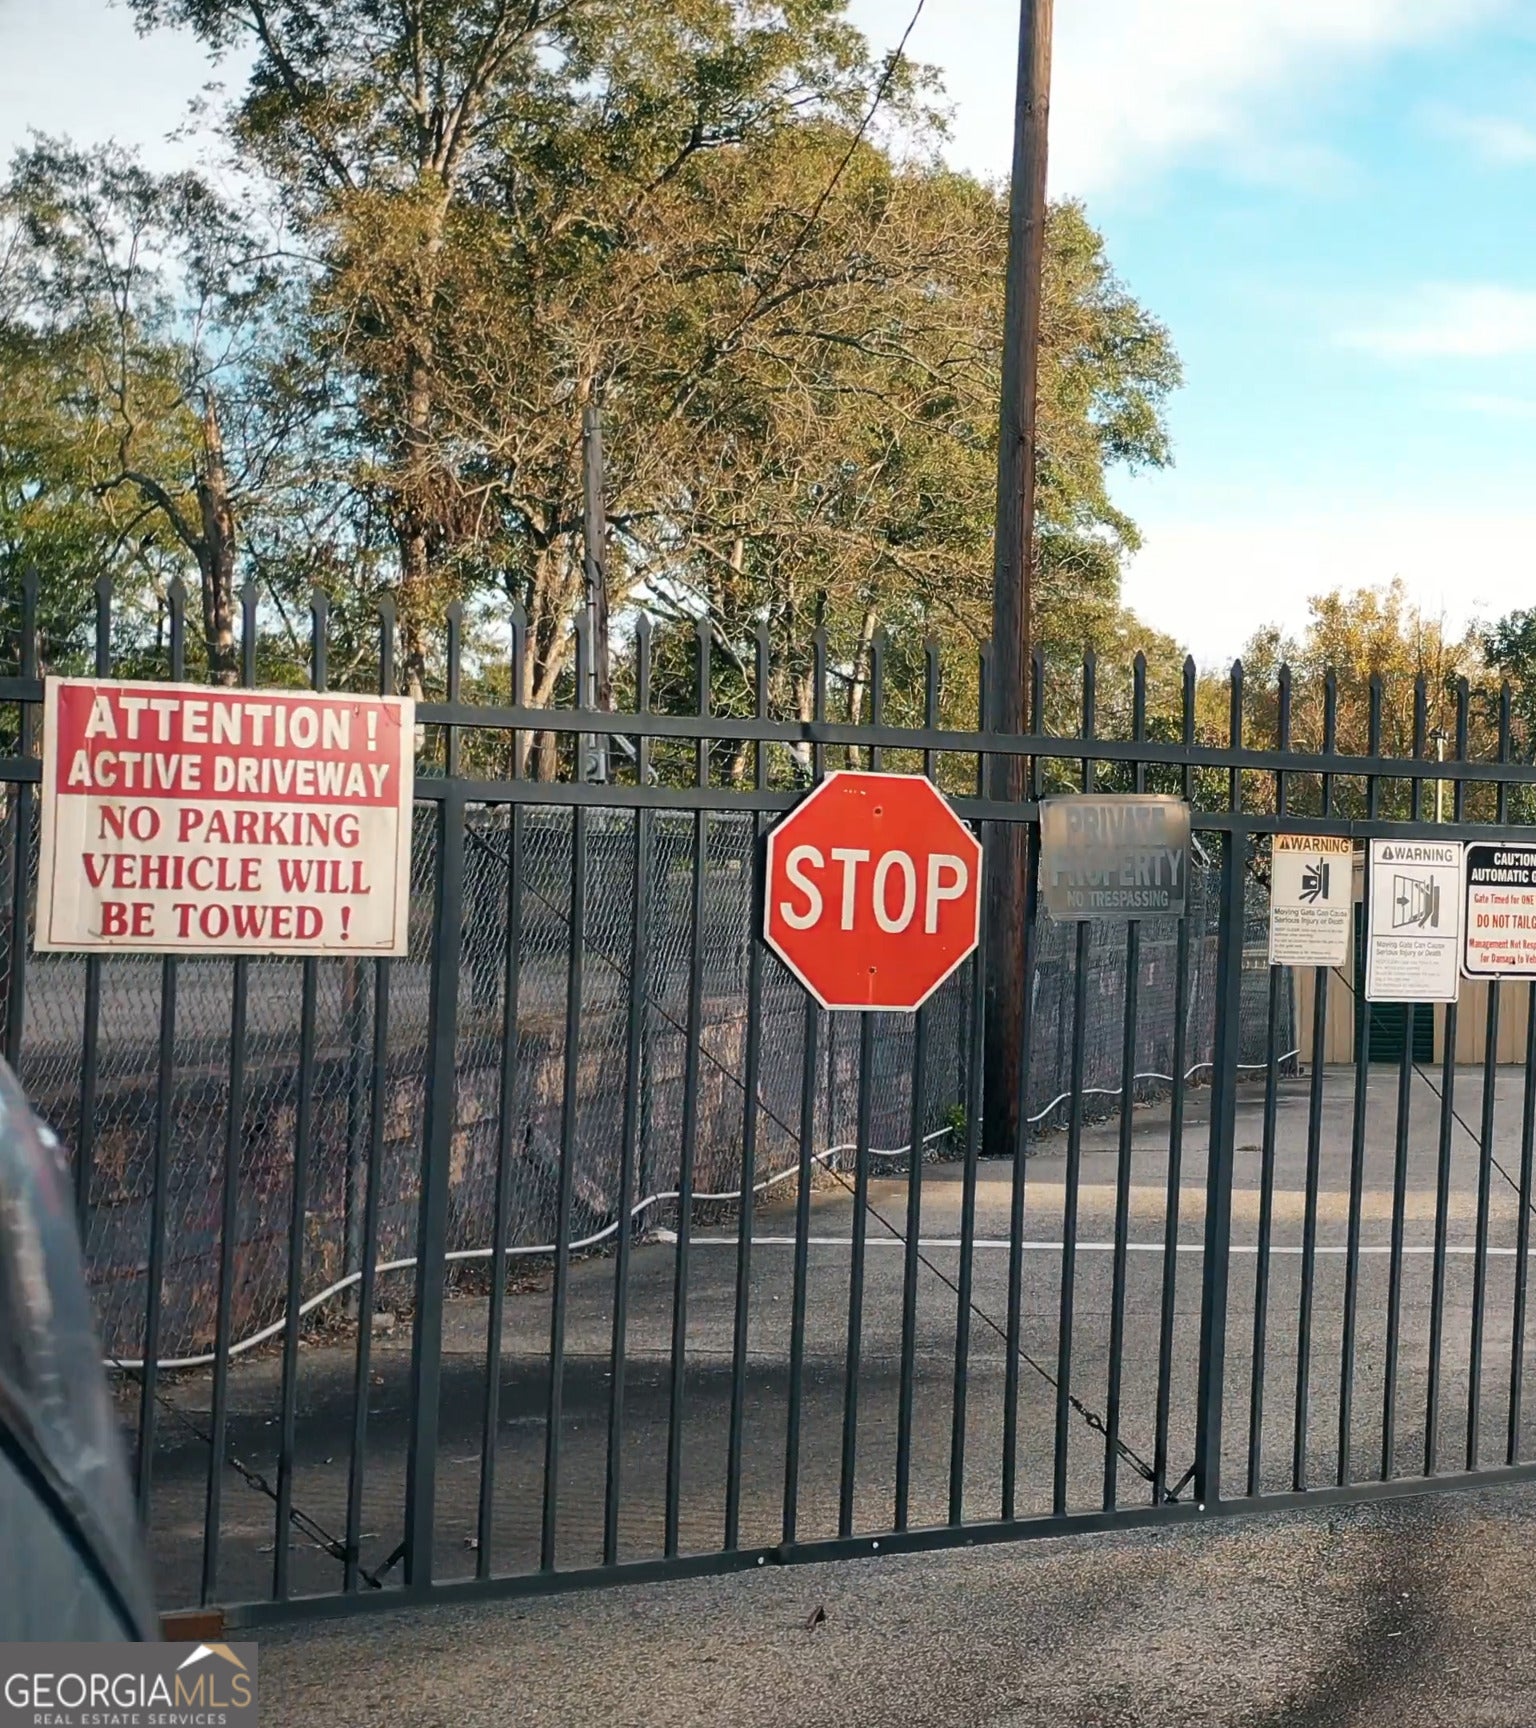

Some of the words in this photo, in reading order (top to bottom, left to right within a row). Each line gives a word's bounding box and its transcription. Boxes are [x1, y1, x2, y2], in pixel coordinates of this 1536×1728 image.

[84, 694, 351, 751] ATTENTION
[366, 710, 378, 752] !
[67, 749, 202, 791] ACTIVE
[213, 755, 390, 798] DRIVEWAY
[97, 804, 161, 842] NO
[178, 807, 360, 848] PARKING
[1065, 806, 1166, 846] PRIVATE
[1291, 837, 1350, 853] WARNING
[1394, 847, 1453, 862] WARNING
[82, 853, 262, 891] VEHICLE
[278, 858, 371, 895] WILL
[1051, 848, 1182, 887] PROPERTY
[1471, 868, 1529, 883] AUTOMATIC
[780, 844, 968, 934] STOP
[1067, 890, 1085, 907] NO
[1088, 890, 1169, 908] TRESPASSING
[1474, 894, 1489, 903] Gate
[1511, 895, 1520, 904] for
[1521, 895, 1534, 905] ONE
[100, 901, 156, 937] BE
[172, 903, 324, 940] TOWED
[340, 905, 352, 942] !
[1477, 914, 1489, 928] DO
[1492, 914, 1510, 928] NOT
[1469, 938, 1508, 950] Management
[1510, 939, 1522, 949] Not
[1480, 953, 1489, 963] for
[1518, 954, 1524, 963] to
